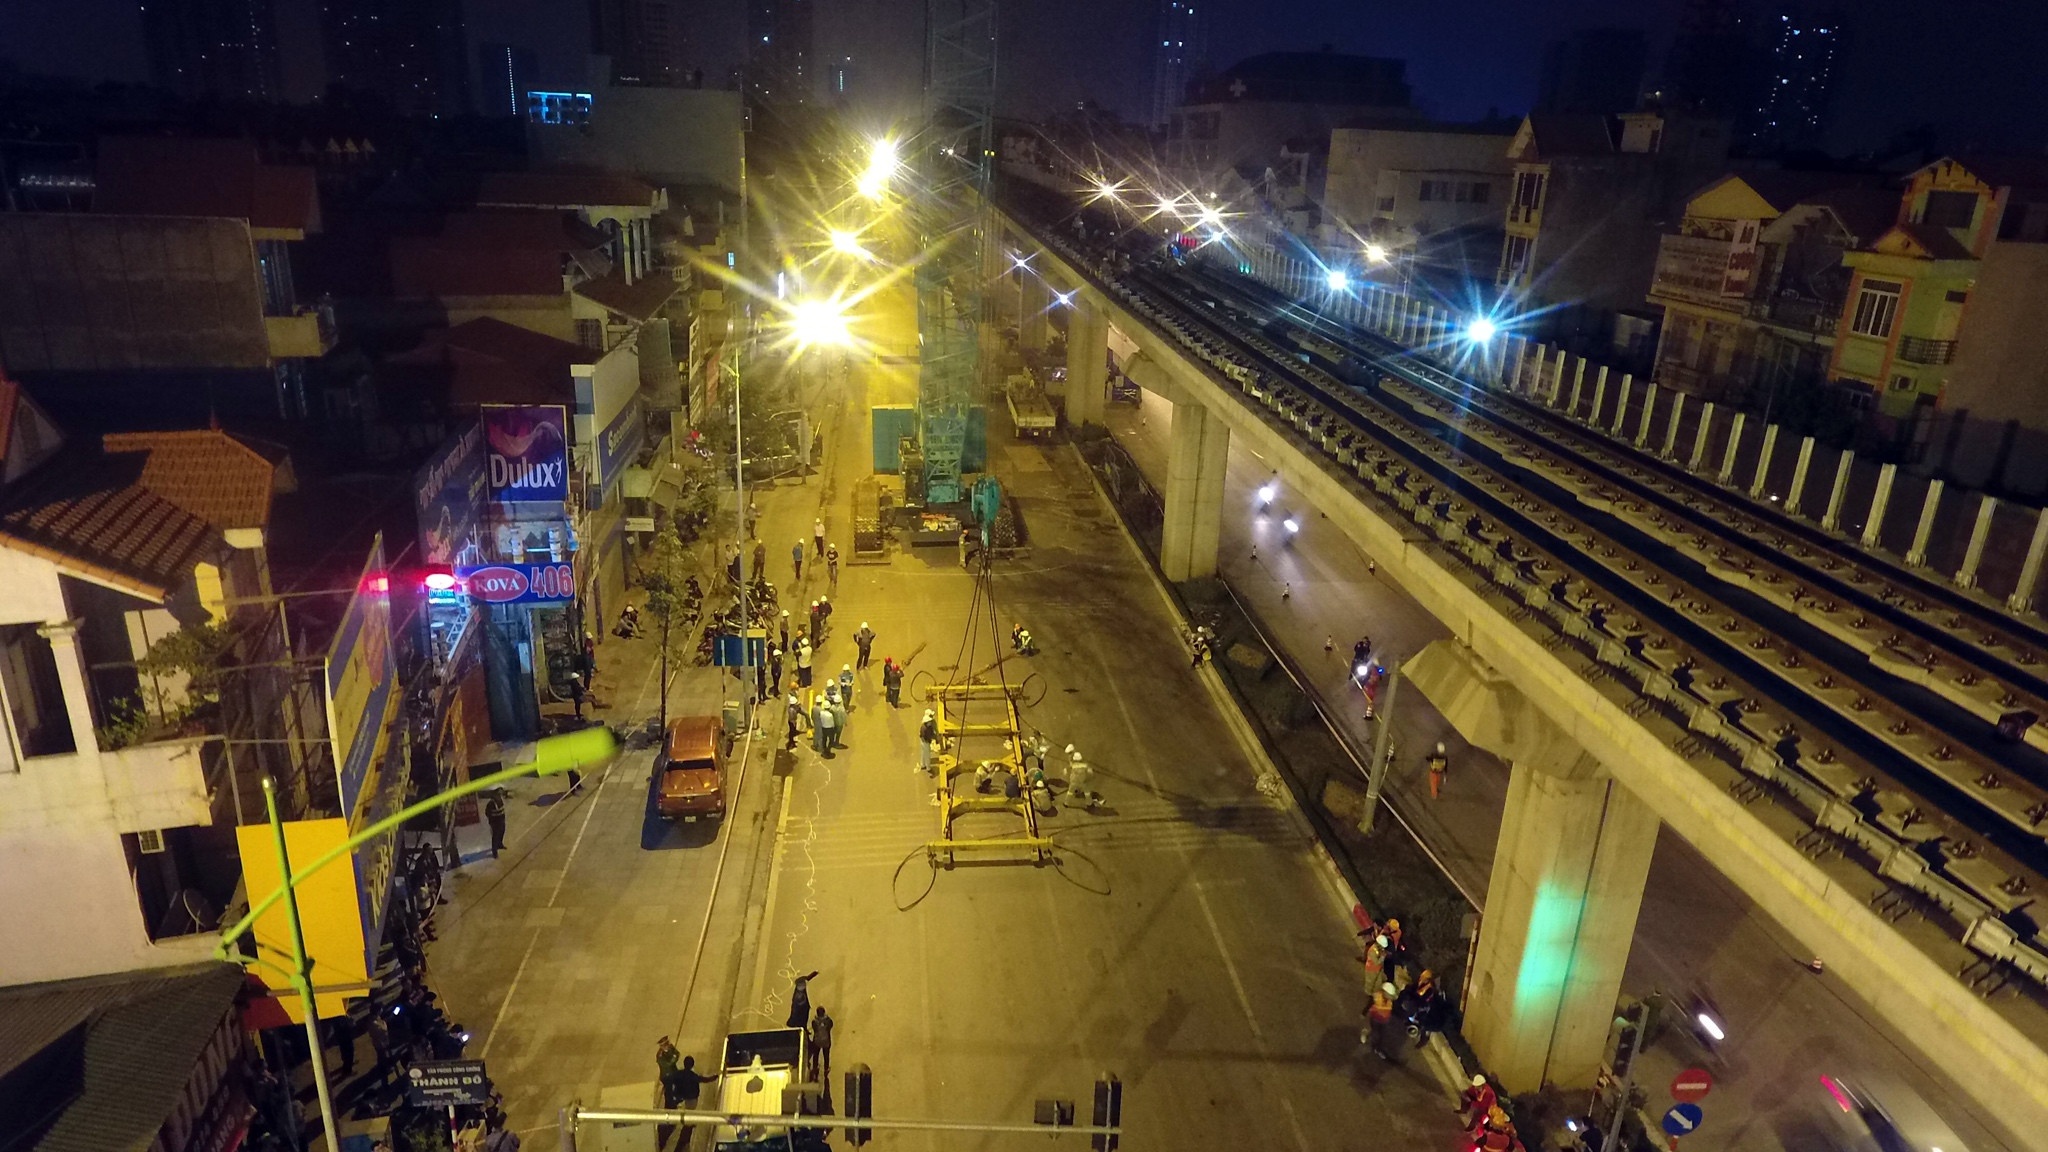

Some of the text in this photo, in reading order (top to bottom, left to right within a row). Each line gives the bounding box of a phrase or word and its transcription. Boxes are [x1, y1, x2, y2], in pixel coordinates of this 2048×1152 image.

[490, 454, 556, 488] Dulux
[475, 577, 520, 593] KOVA
[530, 565, 574, 598] 406
